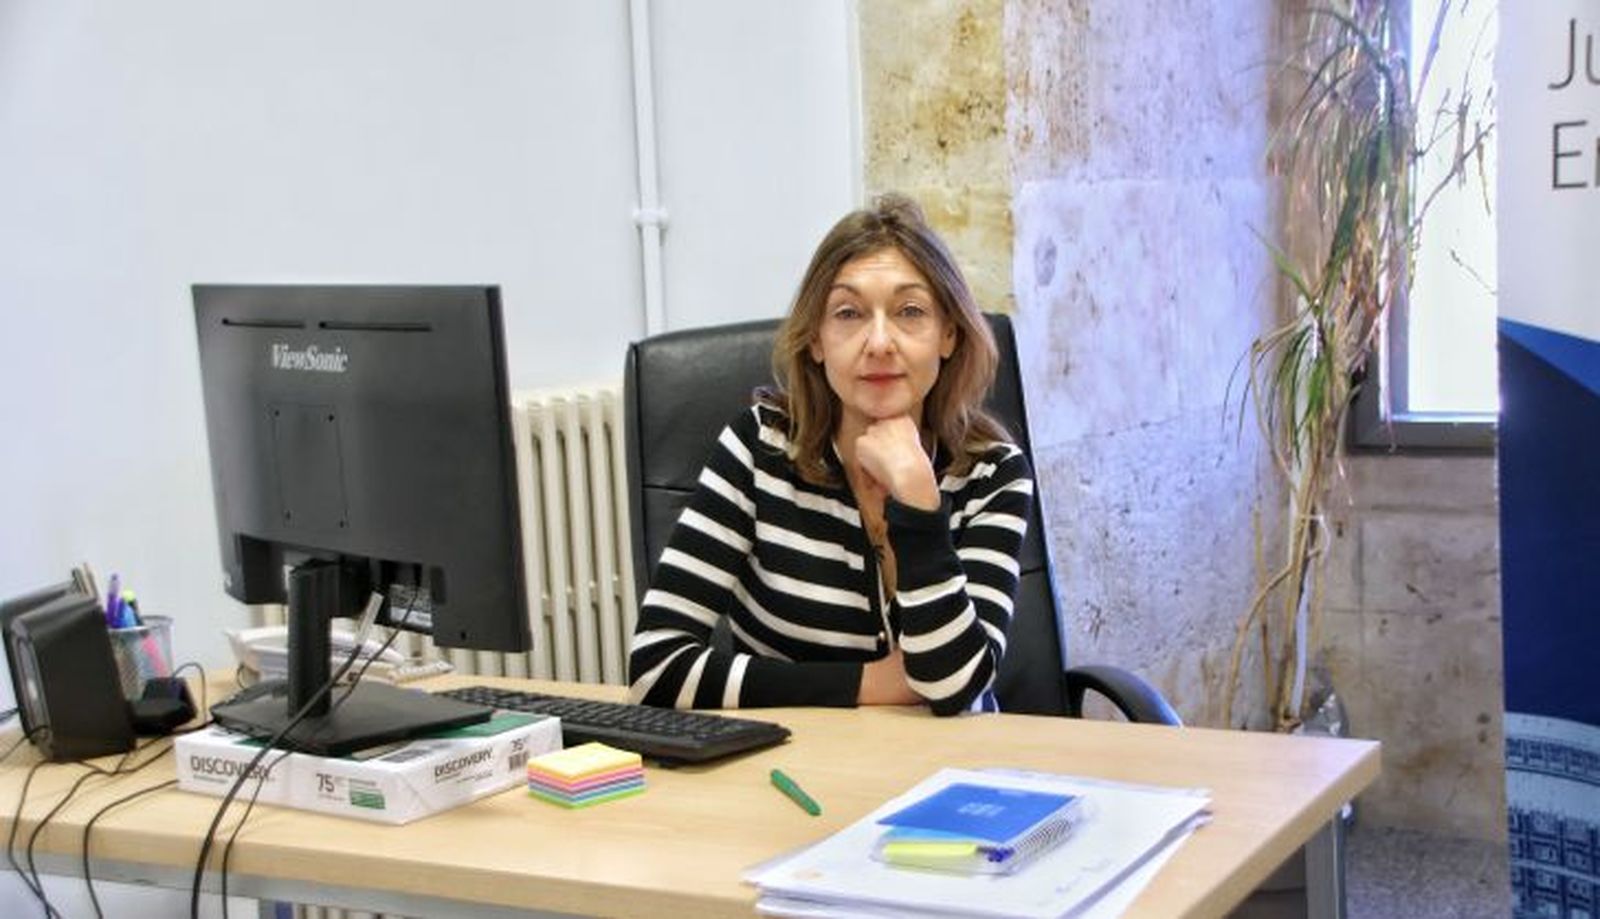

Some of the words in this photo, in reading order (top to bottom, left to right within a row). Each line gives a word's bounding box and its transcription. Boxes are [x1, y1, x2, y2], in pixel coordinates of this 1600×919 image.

[1553, 120, 1600, 189] E
[272, 343, 348, 372] ViewSonic
[434, 747, 493, 777] DISCOVERY
[316, 773, 335, 792] 75
